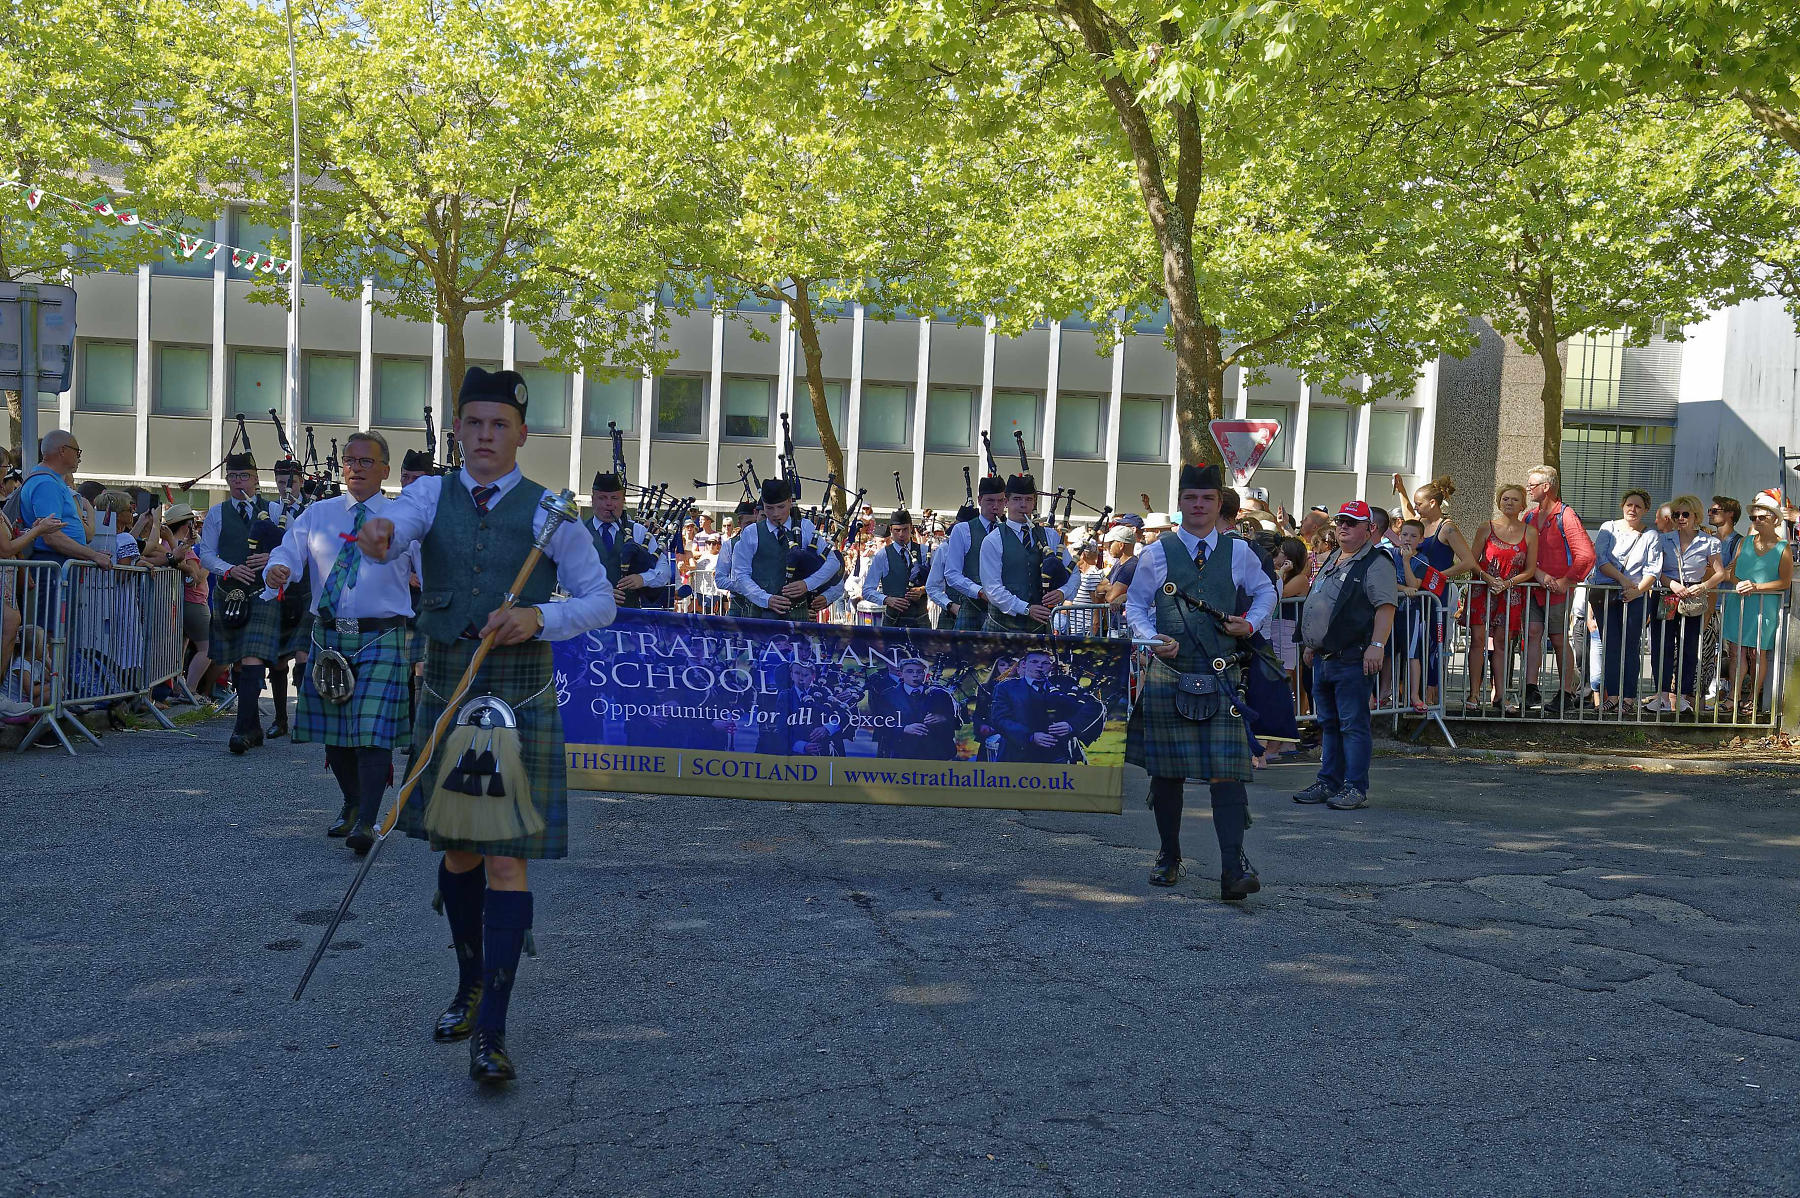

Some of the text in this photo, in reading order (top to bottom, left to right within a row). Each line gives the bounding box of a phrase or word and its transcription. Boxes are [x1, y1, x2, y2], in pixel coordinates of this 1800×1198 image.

[586, 628, 901, 670] STRATHALLAN
[589, 660, 779, 695] SCHOOL
[590, 698, 903, 728] Opportunities for all to excel
[566, 752, 1075, 791] THSHIRE SCOTLAND www.strathallan.co.uk
